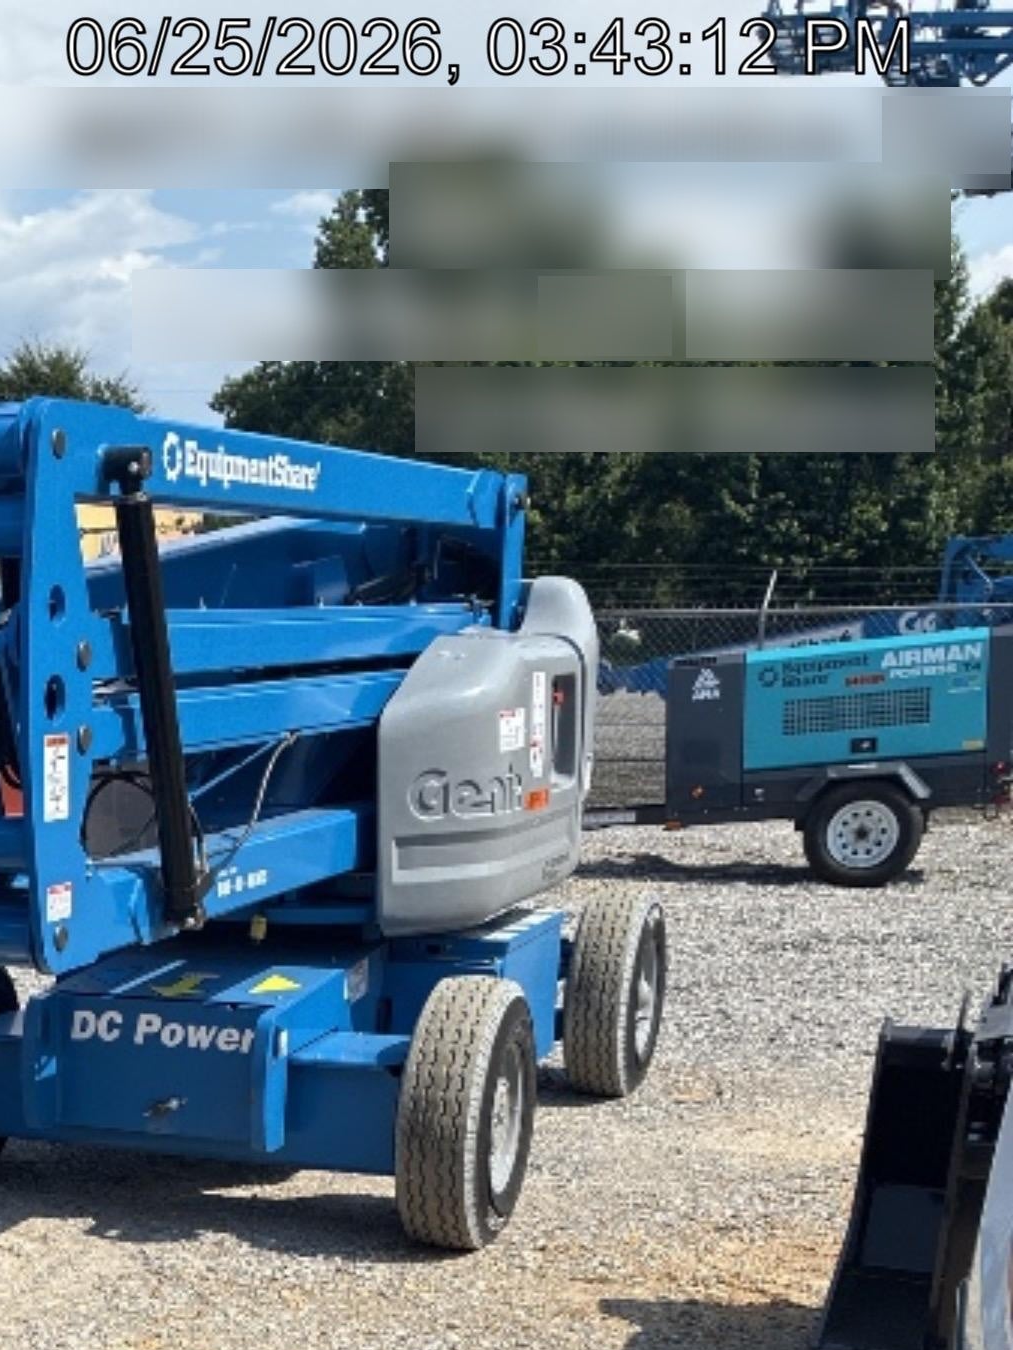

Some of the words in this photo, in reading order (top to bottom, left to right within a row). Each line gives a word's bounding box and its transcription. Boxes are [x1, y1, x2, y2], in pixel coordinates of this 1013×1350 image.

[184, 439, 321, 491] EquipmentShare
[881, 642, 983, 669] AIRMAN
[70, 1009, 123, 1042] DC
[133, 1012, 255, 1053] Power
